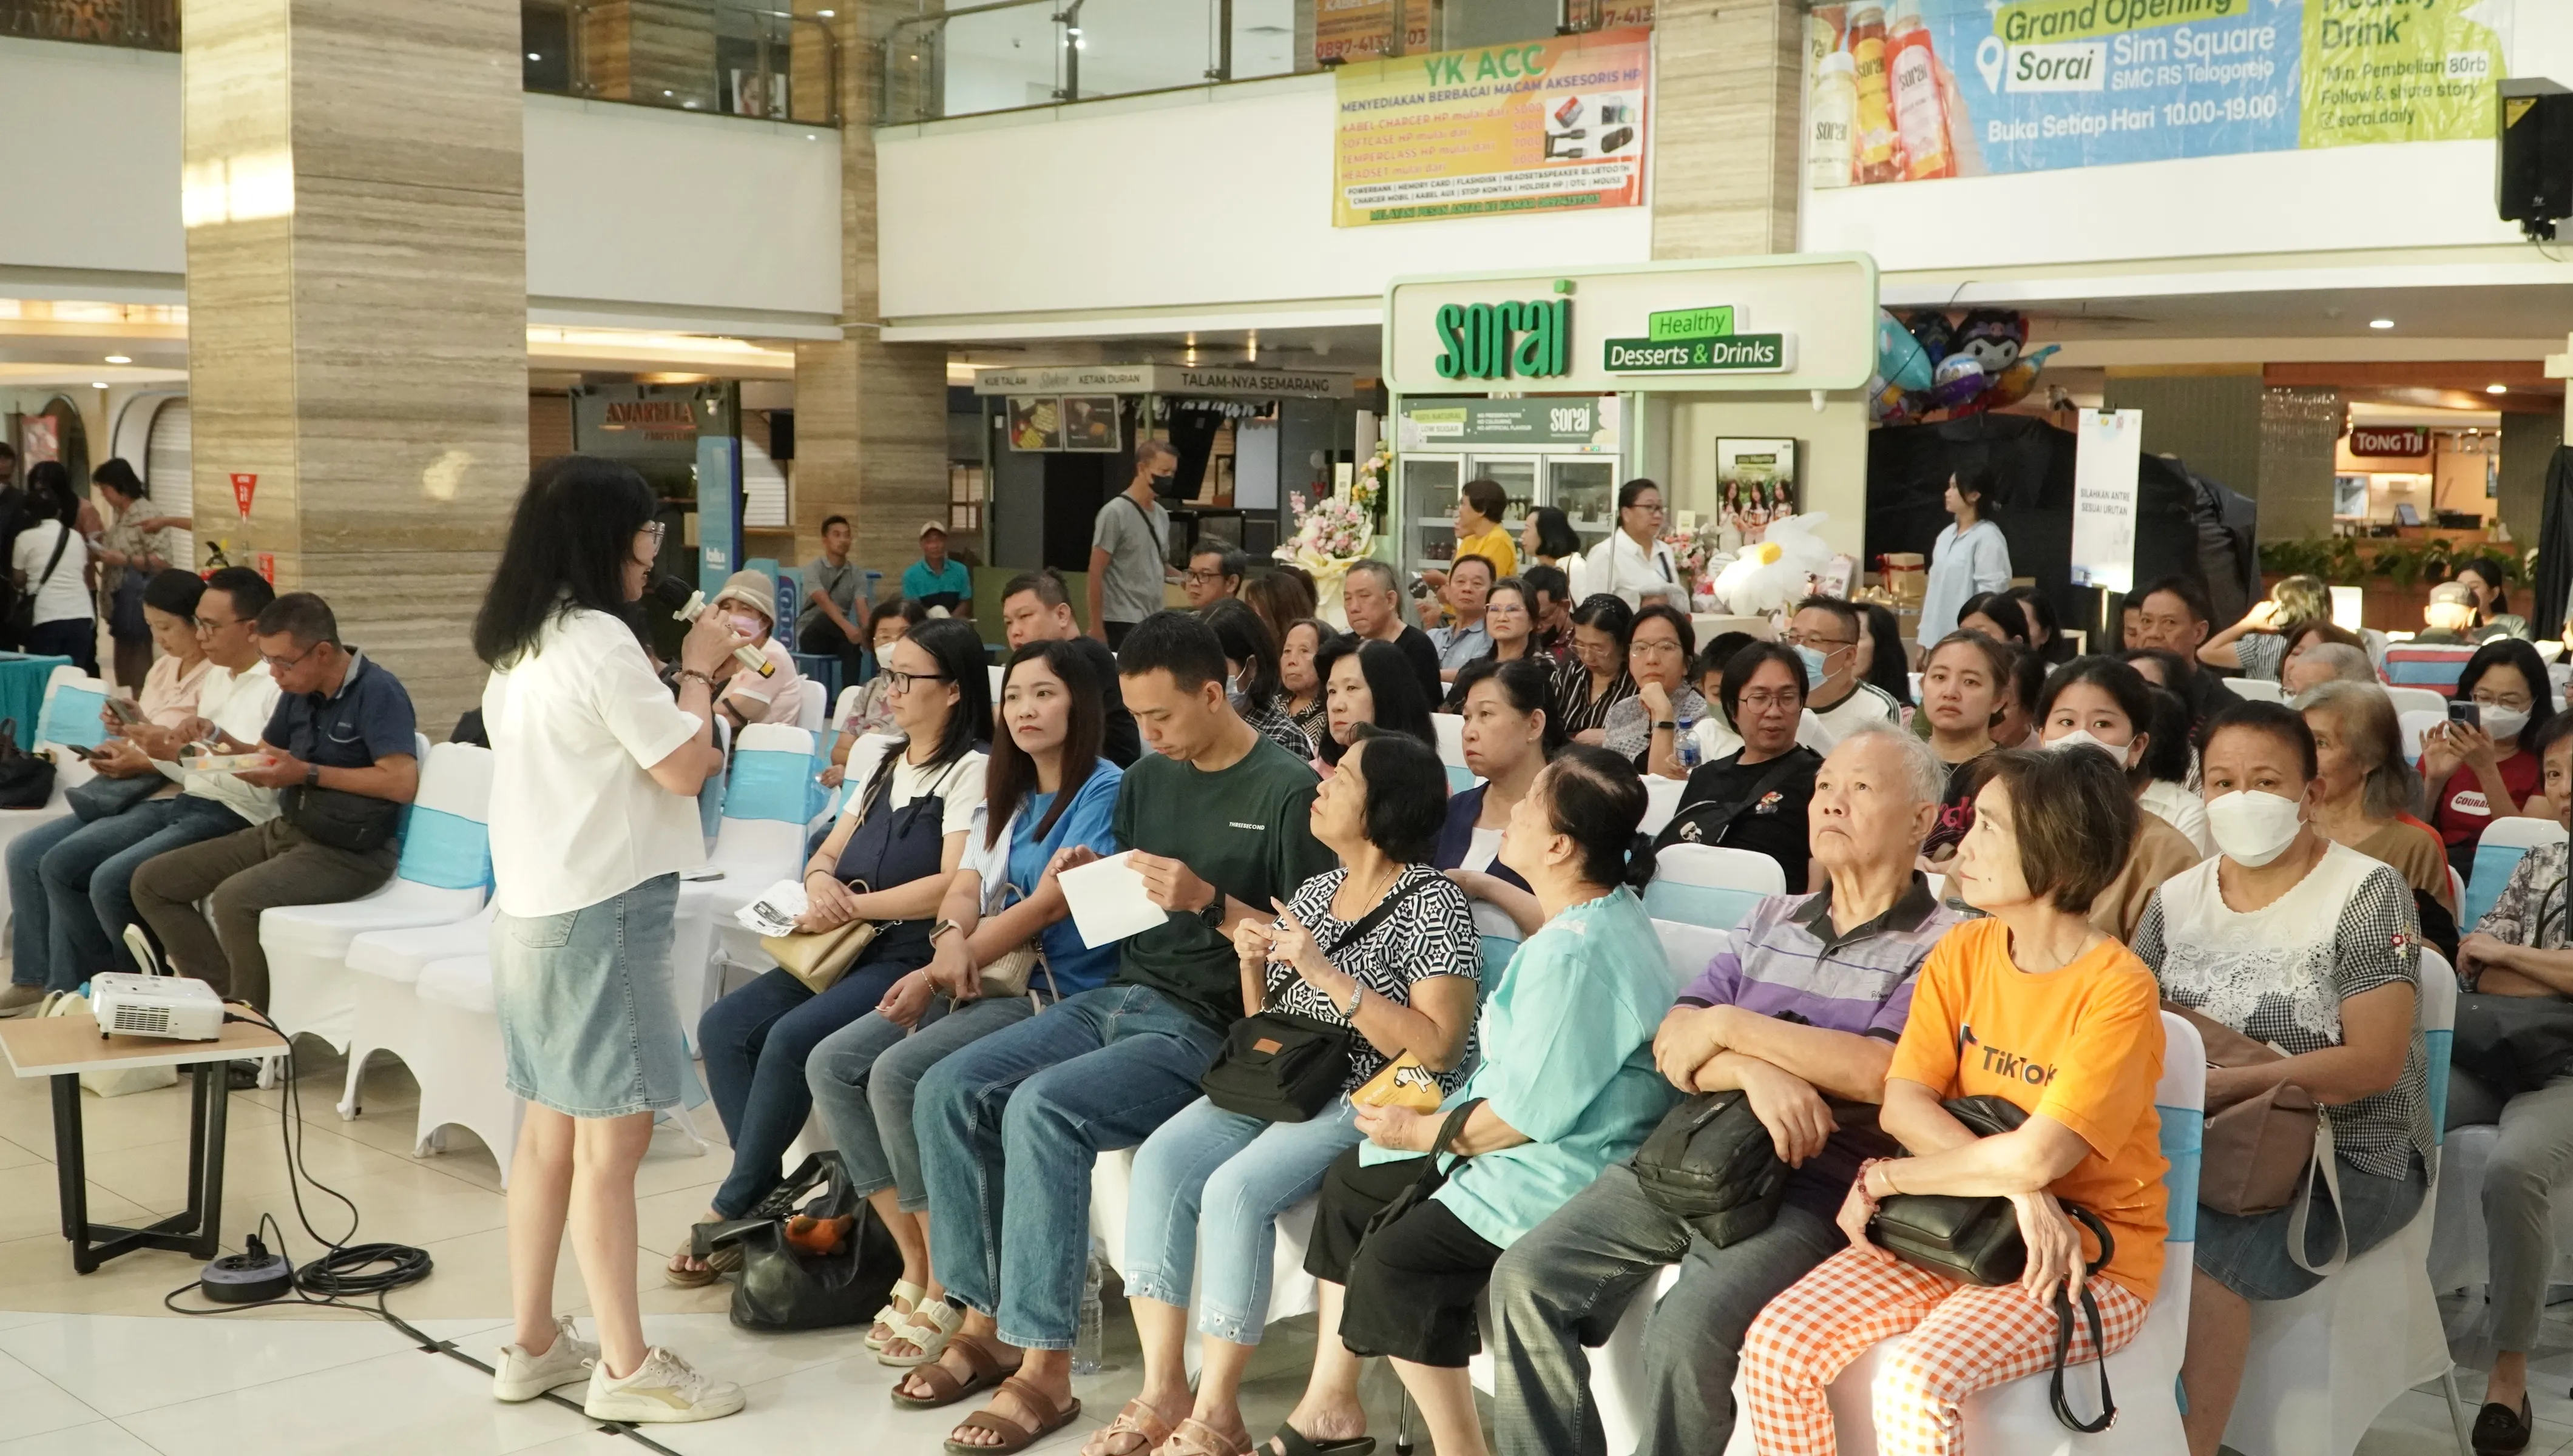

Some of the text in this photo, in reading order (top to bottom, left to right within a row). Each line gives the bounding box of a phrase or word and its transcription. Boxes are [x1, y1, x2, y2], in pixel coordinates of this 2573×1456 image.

[2006, 1, 2097, 42] Grand
[2114, 26, 2276, 65] Sim Square
[1423, 44, 1547, 87] YK ACC
[2016, 49, 2095, 81] Sorai
[2112, 59, 2275, 90] SMC RS Telogorejo
[2362, 59, 2446, 79] Pembelian
[2449, 56, 2487, 73] 80rb
[1341, 68, 1642, 113] MENYEDIAKAN BERBAGAI MACAM AKSESORIS HP
[2321, 89, 2372, 106] Follow
[2436, 82, 2479, 100] story
[1342, 121, 1374, 132] KABEL
[1433, 112, 1449, 121] HP
[1987, 94, 2277, 143] Buka Setiap Hari 10.00-19.00
[1342, 133, 1394, 149] SOFTCASE
[1342, 166, 1388, 180] HEADSET
[1435, 278, 1571, 379] sorai
[1658, 312, 1726, 335] Healthy
[1611, 342, 1774, 366] Desserts & Drinks
[984, 378, 1001, 386] KUE
[1001, 377, 1027, 386] TALAM
[1078, 375, 1106, 384] KETAN
[1107, 374, 1140, 384] DURIAN
[1182, 373, 1330, 393] TALAM-NYA SEMARANG
[1550, 402, 1591, 433] sorai
[2356, 432, 2402, 451] TONG
[2080, 487, 2131, 502] SILAHKAN ANTRE
[2081, 502, 2128, 516] SESUAI URUTAN
[1229, 821, 1265, 831] THREESECOND
[1983, 1045, 2059, 1087] TikTok
